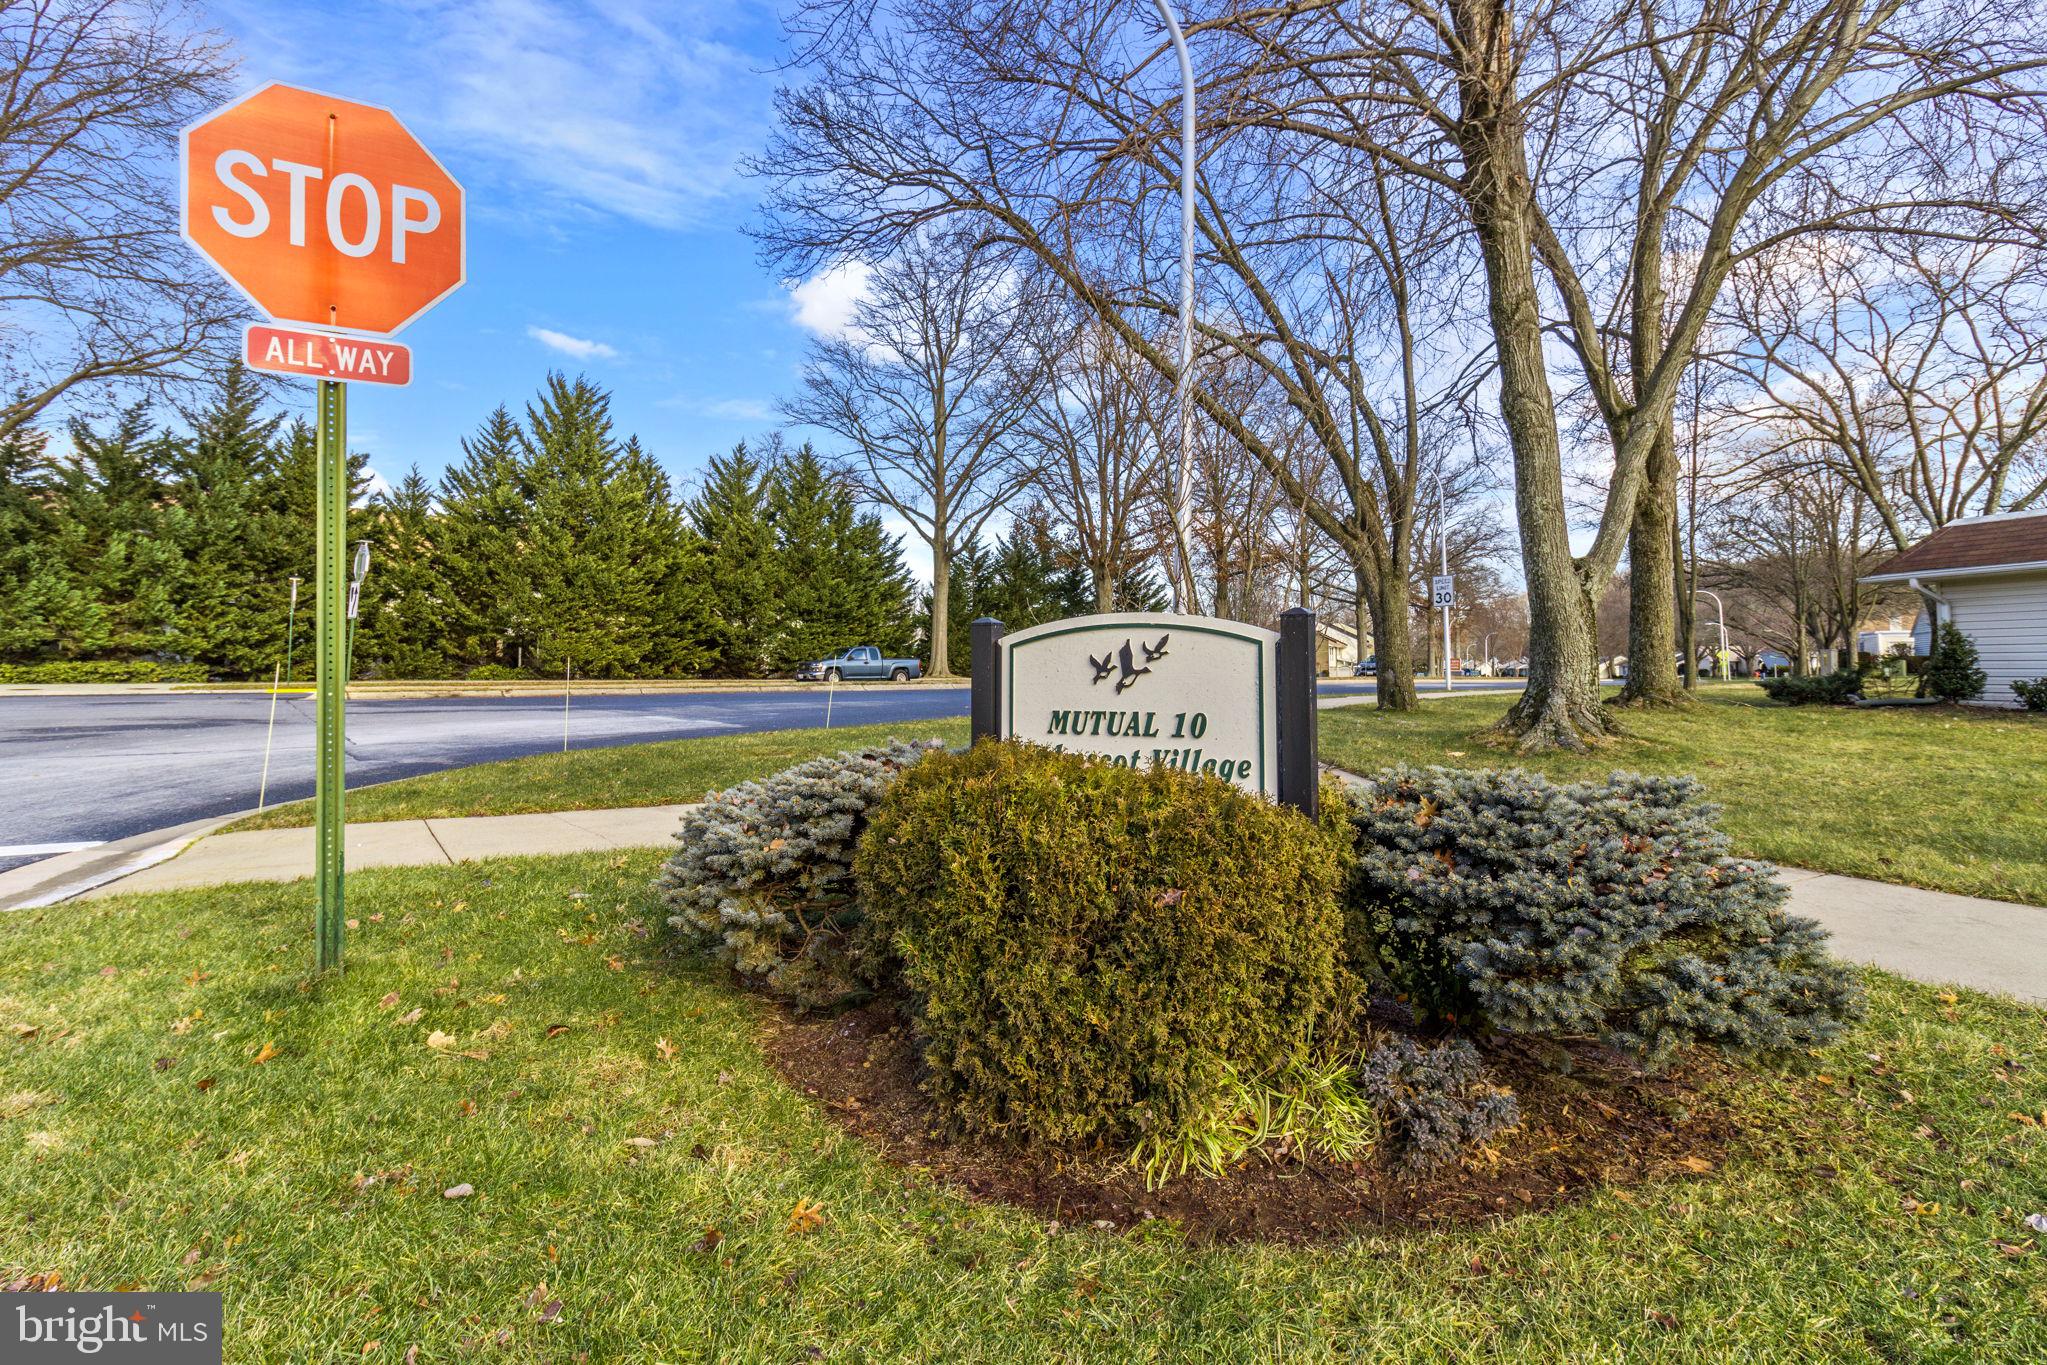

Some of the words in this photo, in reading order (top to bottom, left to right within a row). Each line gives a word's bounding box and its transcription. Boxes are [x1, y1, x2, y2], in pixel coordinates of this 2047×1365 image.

[211, 149, 441, 264] STOP
[265, 336, 323, 369] ALL
[335, 344, 394, 377] WAY
[1435, 592, 1452, 604] 30
[1047, 710, 1159, 737] MUTUAL
[1171, 712, 1207, 739] 10
